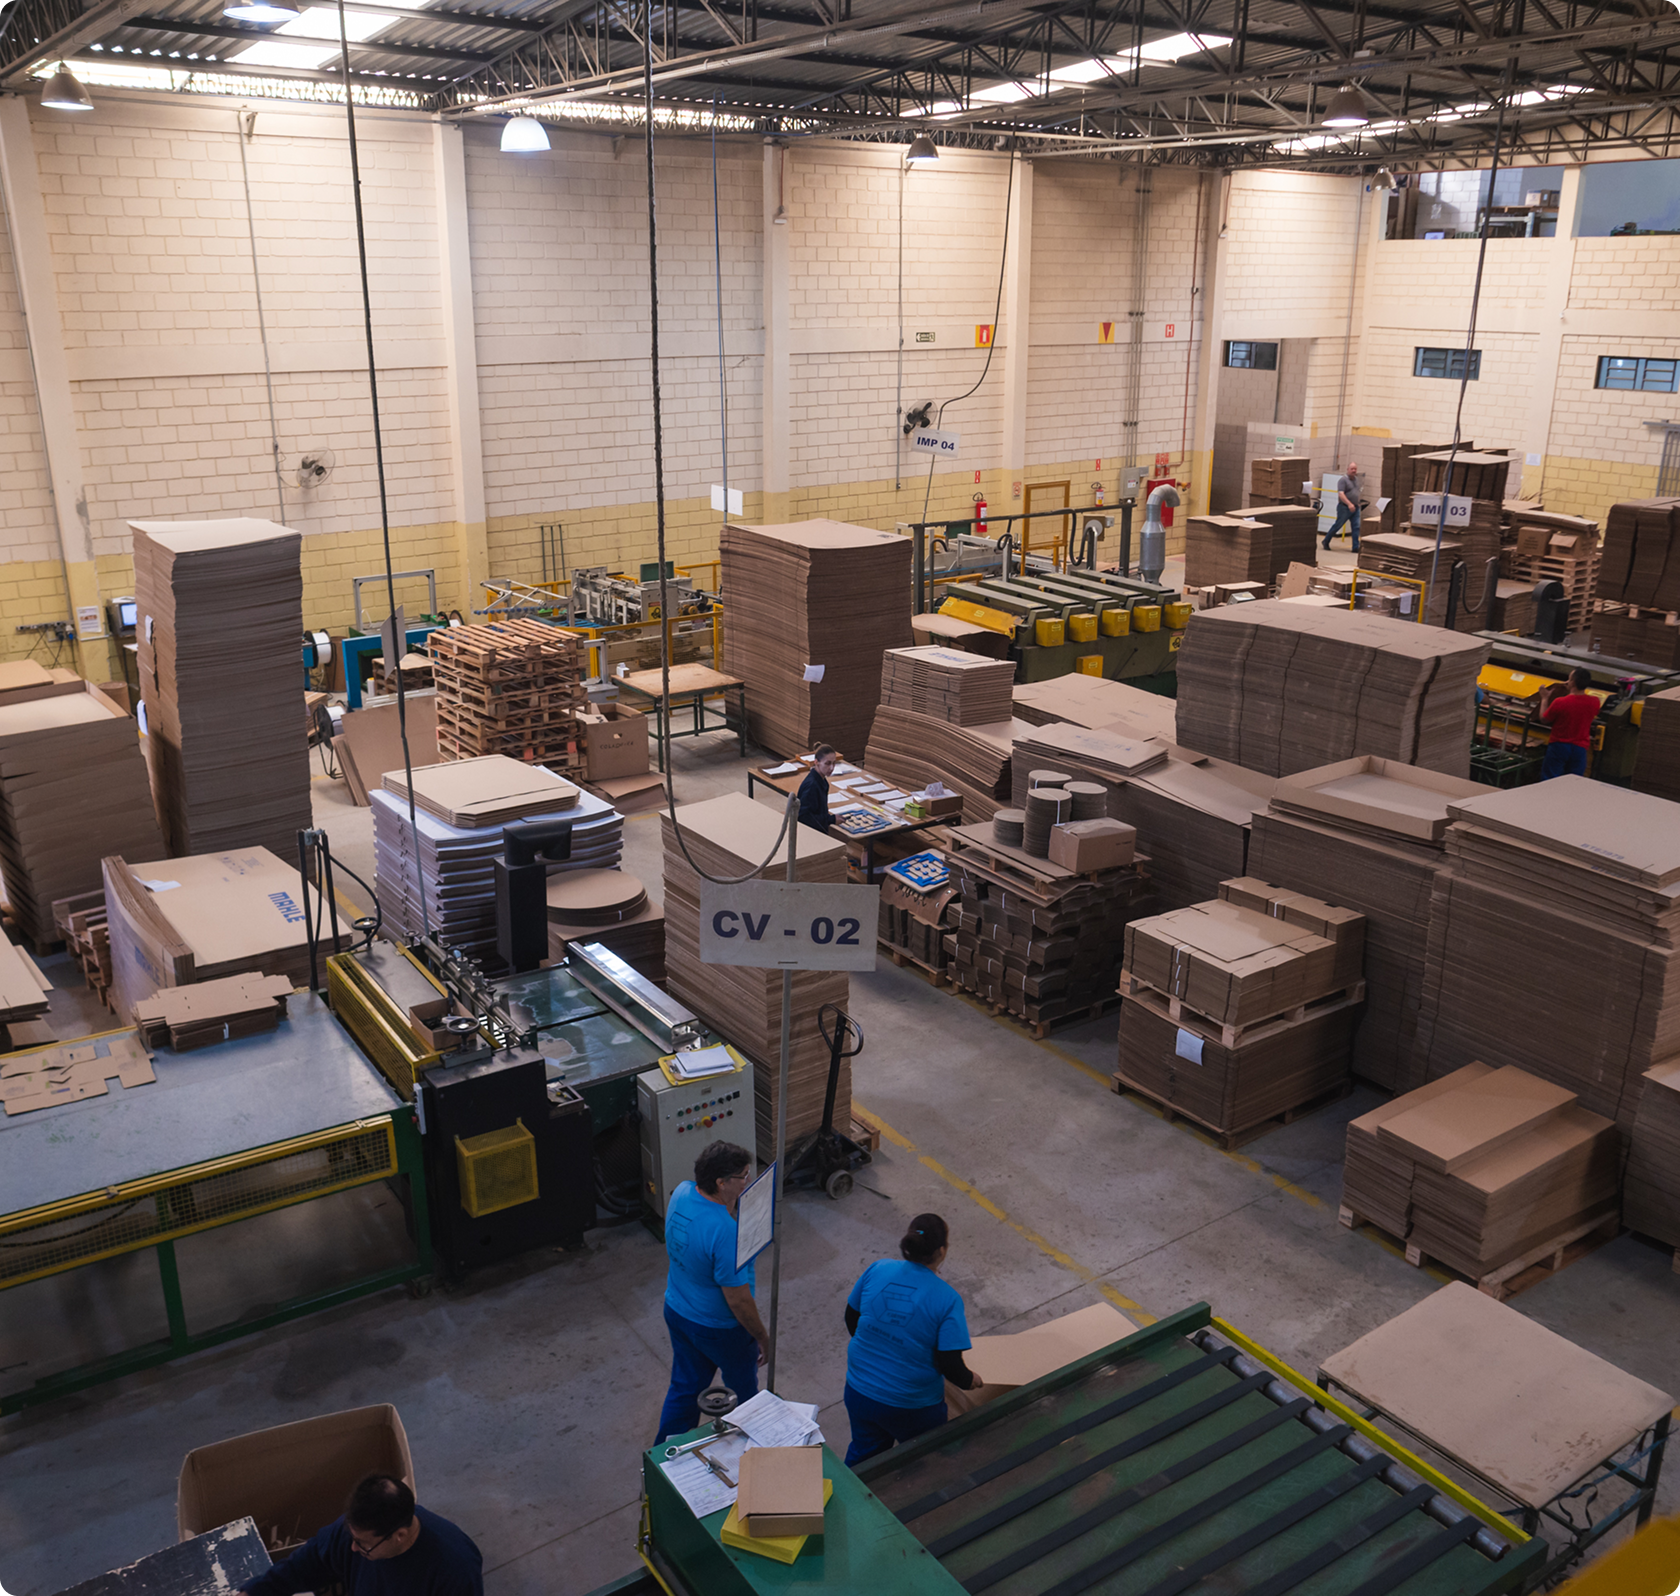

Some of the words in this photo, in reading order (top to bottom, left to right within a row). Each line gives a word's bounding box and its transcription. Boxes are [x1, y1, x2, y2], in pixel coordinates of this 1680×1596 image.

[917, 436, 938, 447] IMP
[941, 440, 955, 451] 04
[1450, 506, 1467, 517] 03
[267, 891, 306, 924] MAHLE
[712, 910, 771, 941] CV
[783, 929, 796, 937] -
[810, 916, 861, 945] 02
